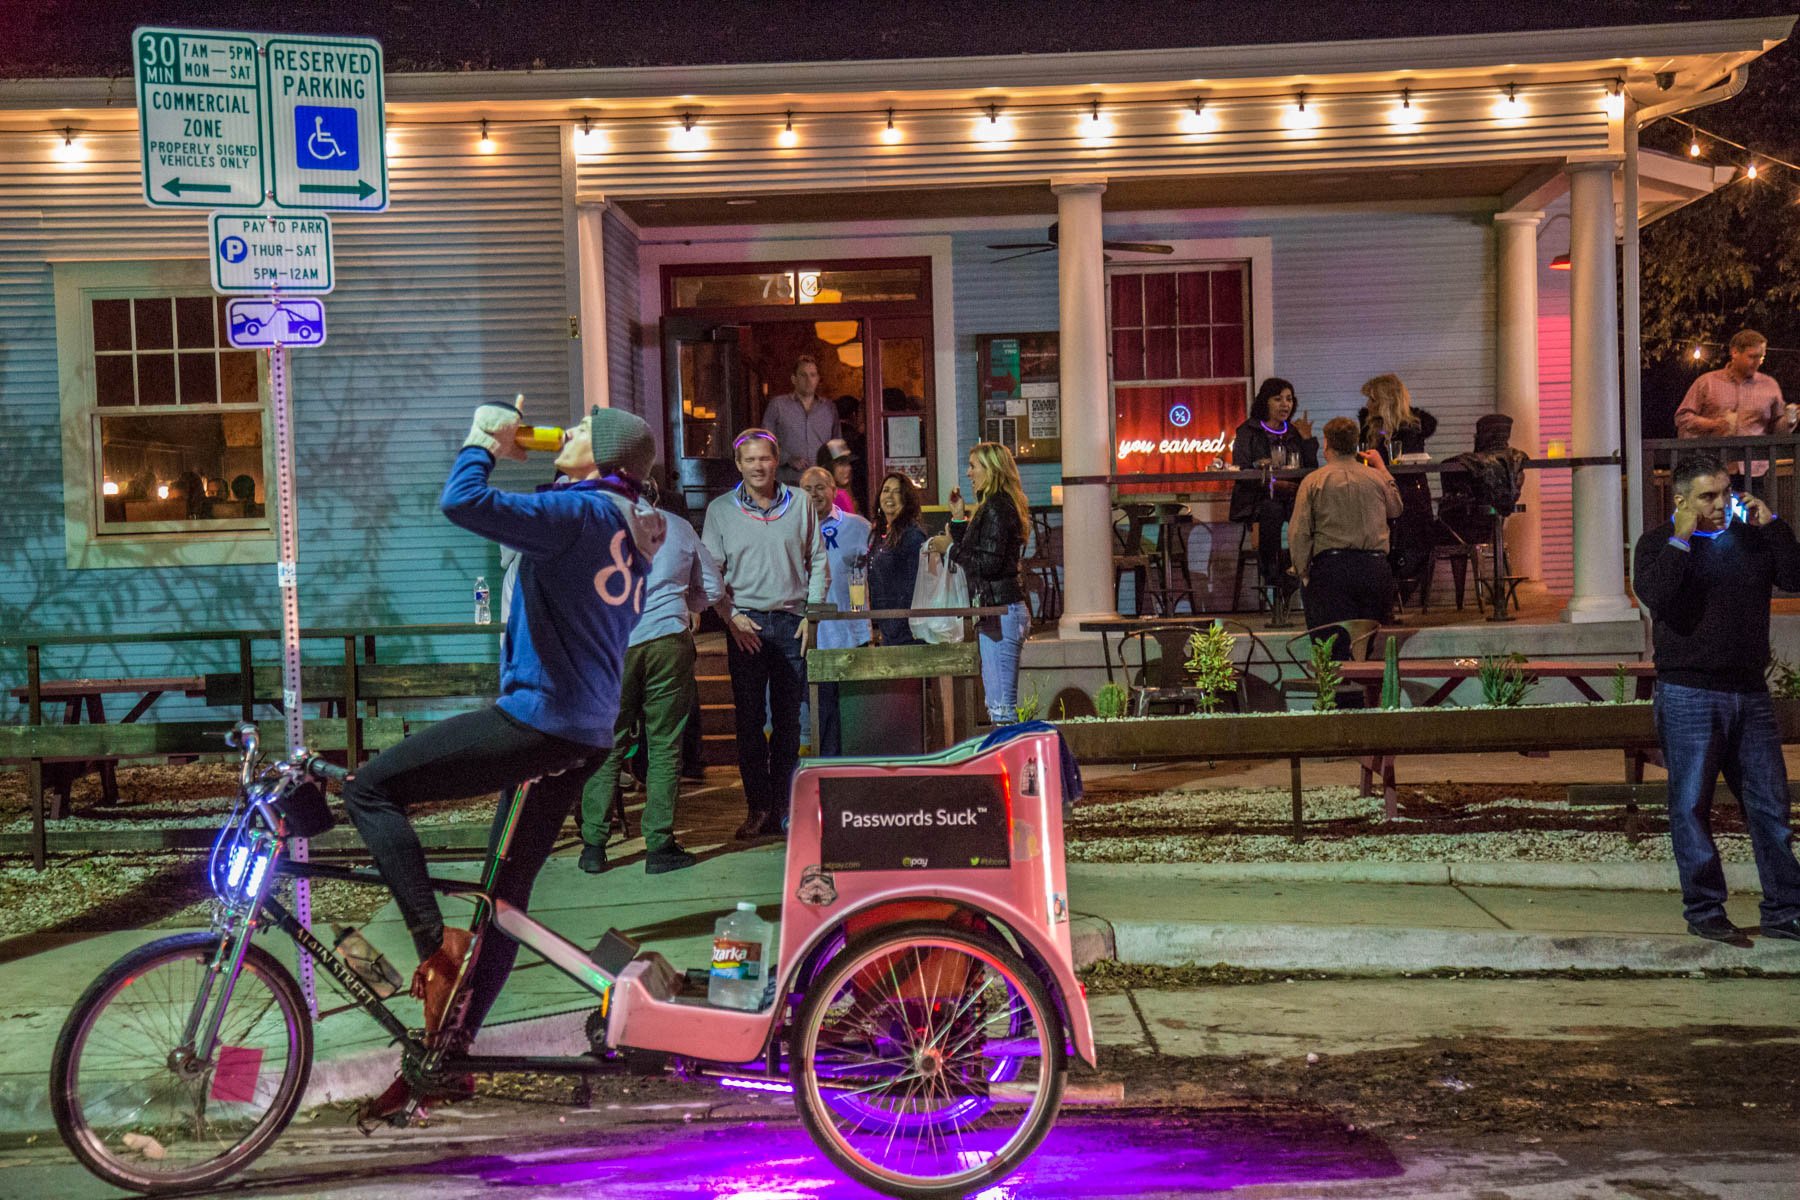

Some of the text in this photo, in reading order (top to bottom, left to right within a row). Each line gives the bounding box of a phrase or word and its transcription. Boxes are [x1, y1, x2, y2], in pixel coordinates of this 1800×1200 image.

[142, 36, 175, 66] 30
[274, 49, 371, 75] RESERVED
[146, 67, 174, 84] MIN
[283, 75, 365, 99] PARKING
[152, 91, 250, 114] COMMERCIAL
[183, 118, 223, 138] ZONE
[150, 141, 257, 156] PROPERLY SIGNED
[160, 154, 249, 169] VEHICLES ONLY
[242, 221, 323, 234] PAY TO PARK
[1117, 438, 1156, 460] you
[1158, 431, 1226, 454] earned
[841, 808, 933, 828] Passwords
[712, 946, 748, 962] zarka
[334, 962, 377, 1005] STREET
